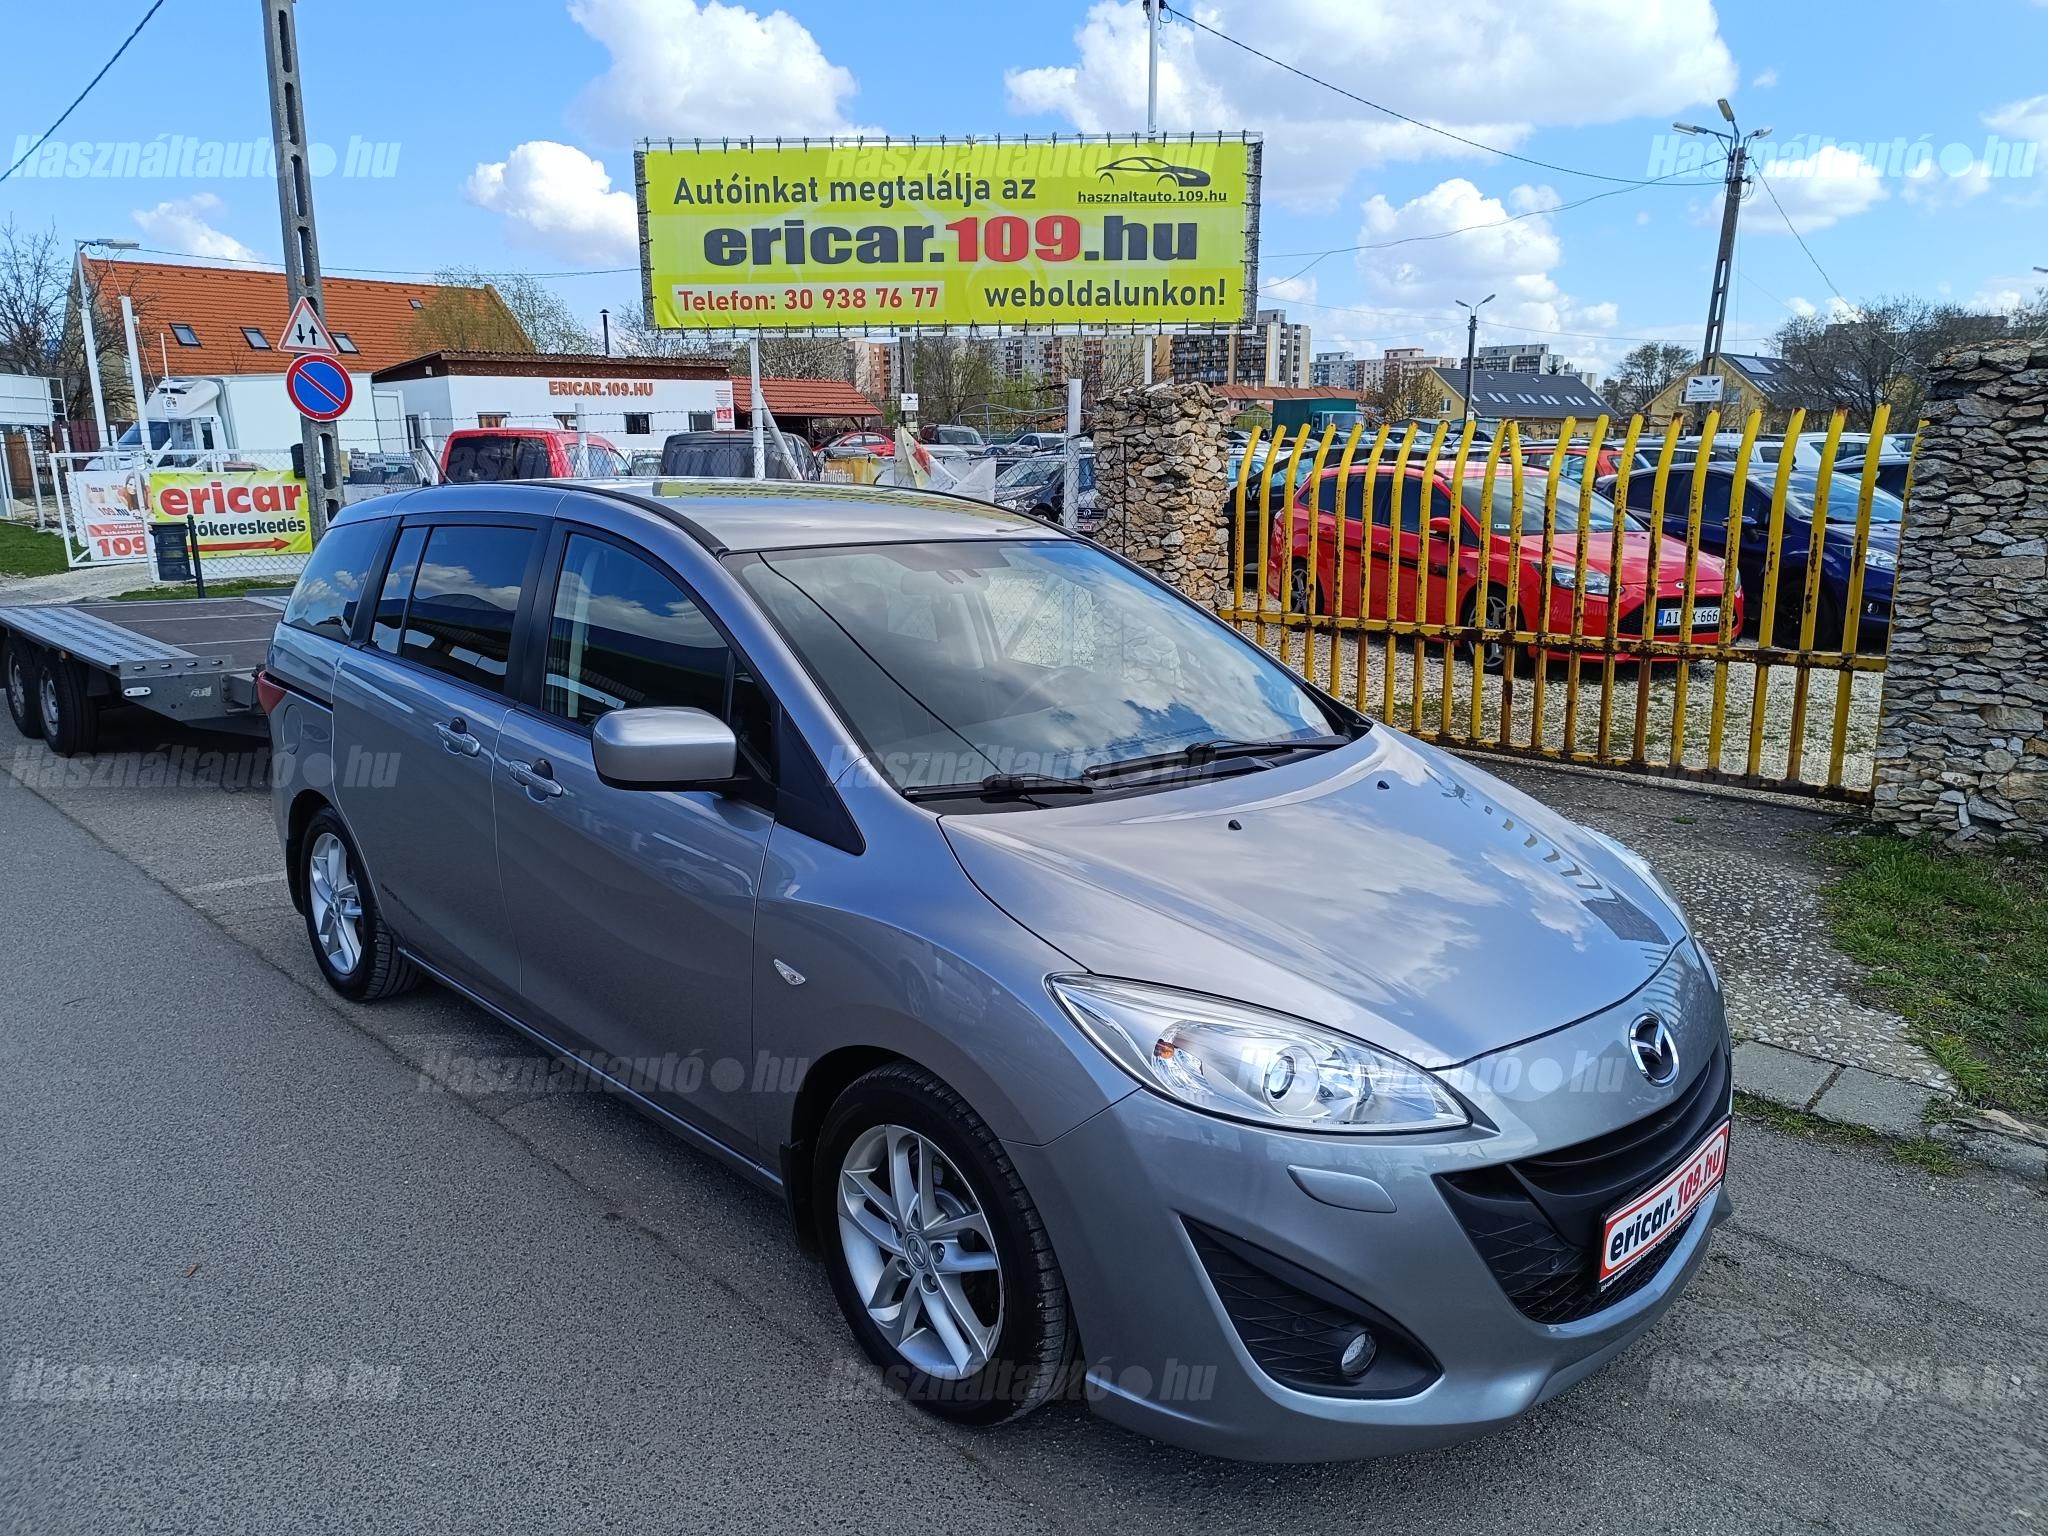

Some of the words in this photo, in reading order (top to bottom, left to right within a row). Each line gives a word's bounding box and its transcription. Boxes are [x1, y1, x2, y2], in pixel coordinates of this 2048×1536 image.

[673, 172, 819, 205] Autóinkat
[830, 169, 991, 209] megtalálja
[1001, 178, 1037, 200] az
[1077, 190, 1228, 203] hasznaltauto.109.hu
[703, 215, 1198, 267] ericar.109.hu
[677, 289, 776, 312] Telefon:
[783, 288, 814, 310] 30
[821, 287, 867, 309] 938
[874, 286, 903, 309] 76
[910, 286, 939, 308] 77
[984, 278, 1226, 308] weboldalunkon!
[548, 381, 654, 397] ERICAR.109.HU
[159, 481, 302, 517] ericar
[1609, 1144, 1723, 1263] ericar.109.hu
